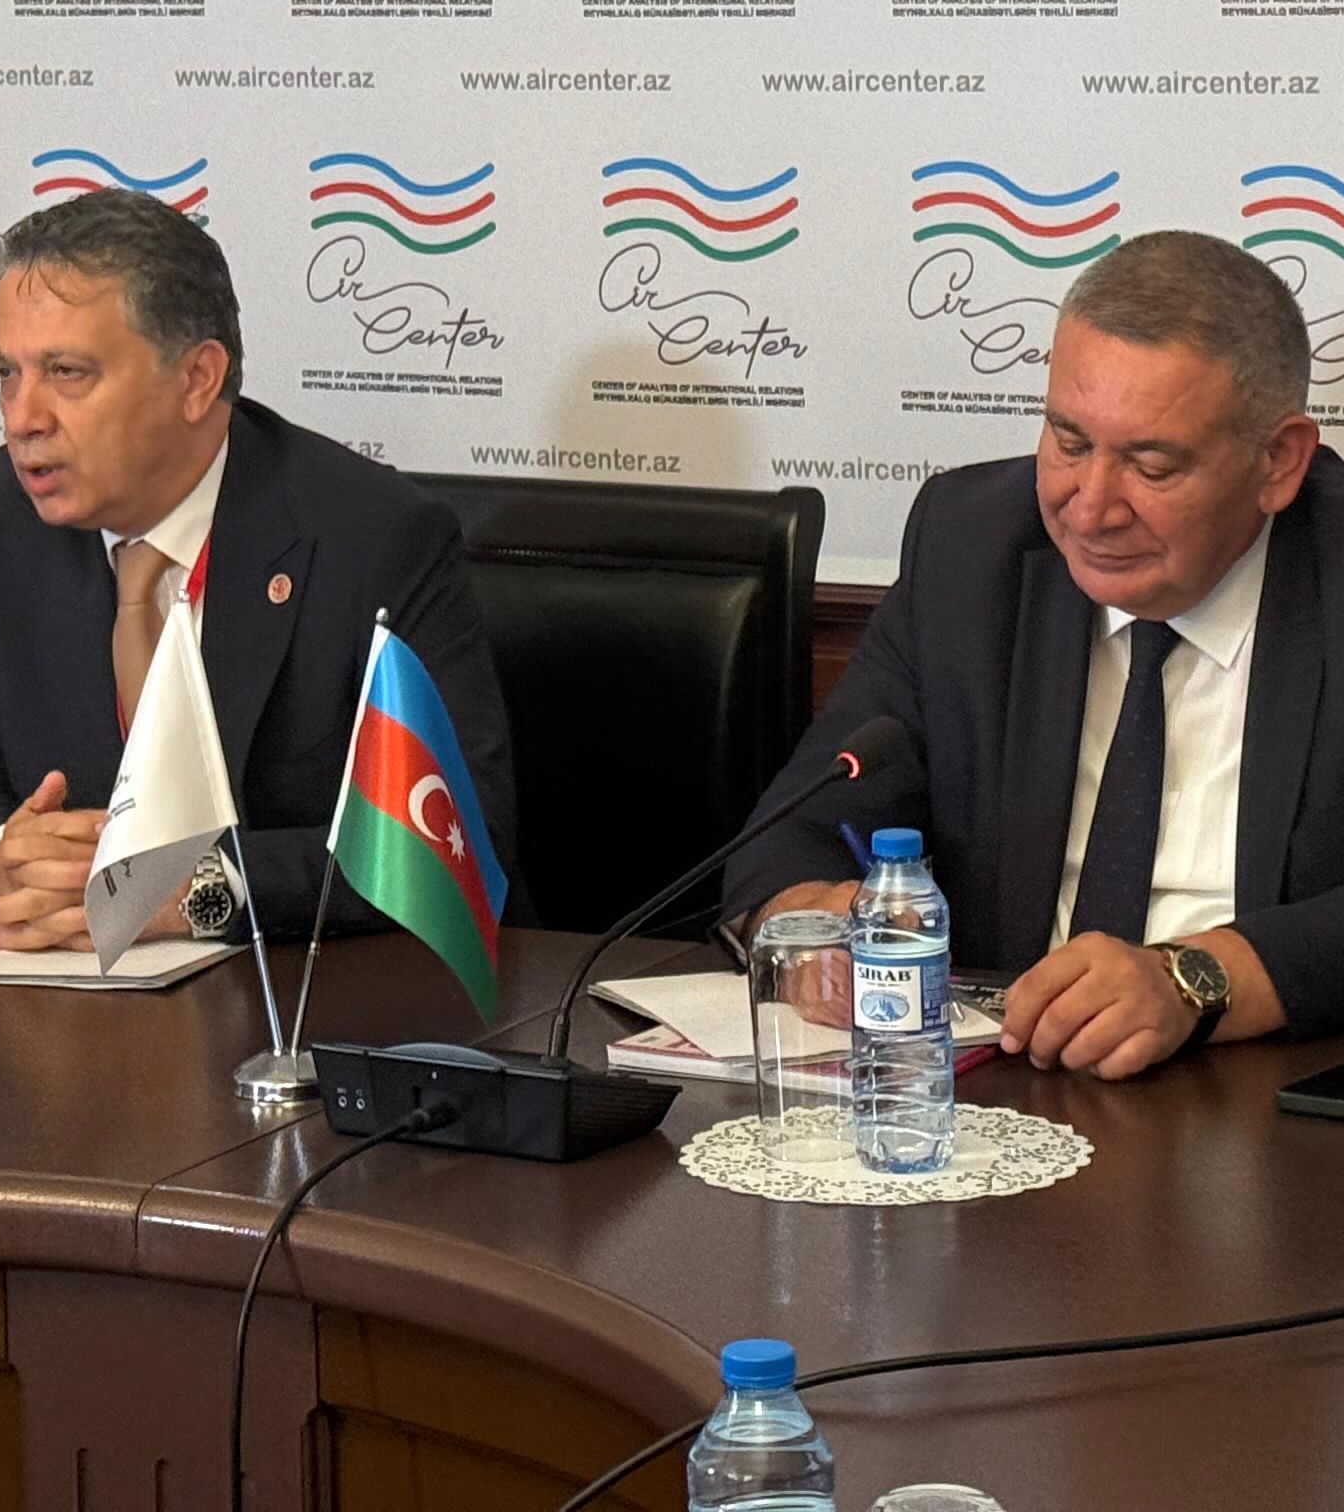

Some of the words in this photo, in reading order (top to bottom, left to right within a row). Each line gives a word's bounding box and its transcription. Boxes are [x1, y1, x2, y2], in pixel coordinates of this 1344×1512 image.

[175, 66, 375, 88] www.aircenter.az
[460, 68, 671, 91] www.aircenter.az
[762, 69, 985, 92] www.aircenter.az
[1082, 70, 1320, 95] www.aircenter.az
[353, 306, 505, 370] Center
[647, 315, 808, 380] Center
[471, 445, 680, 472] www.aircenter.az
